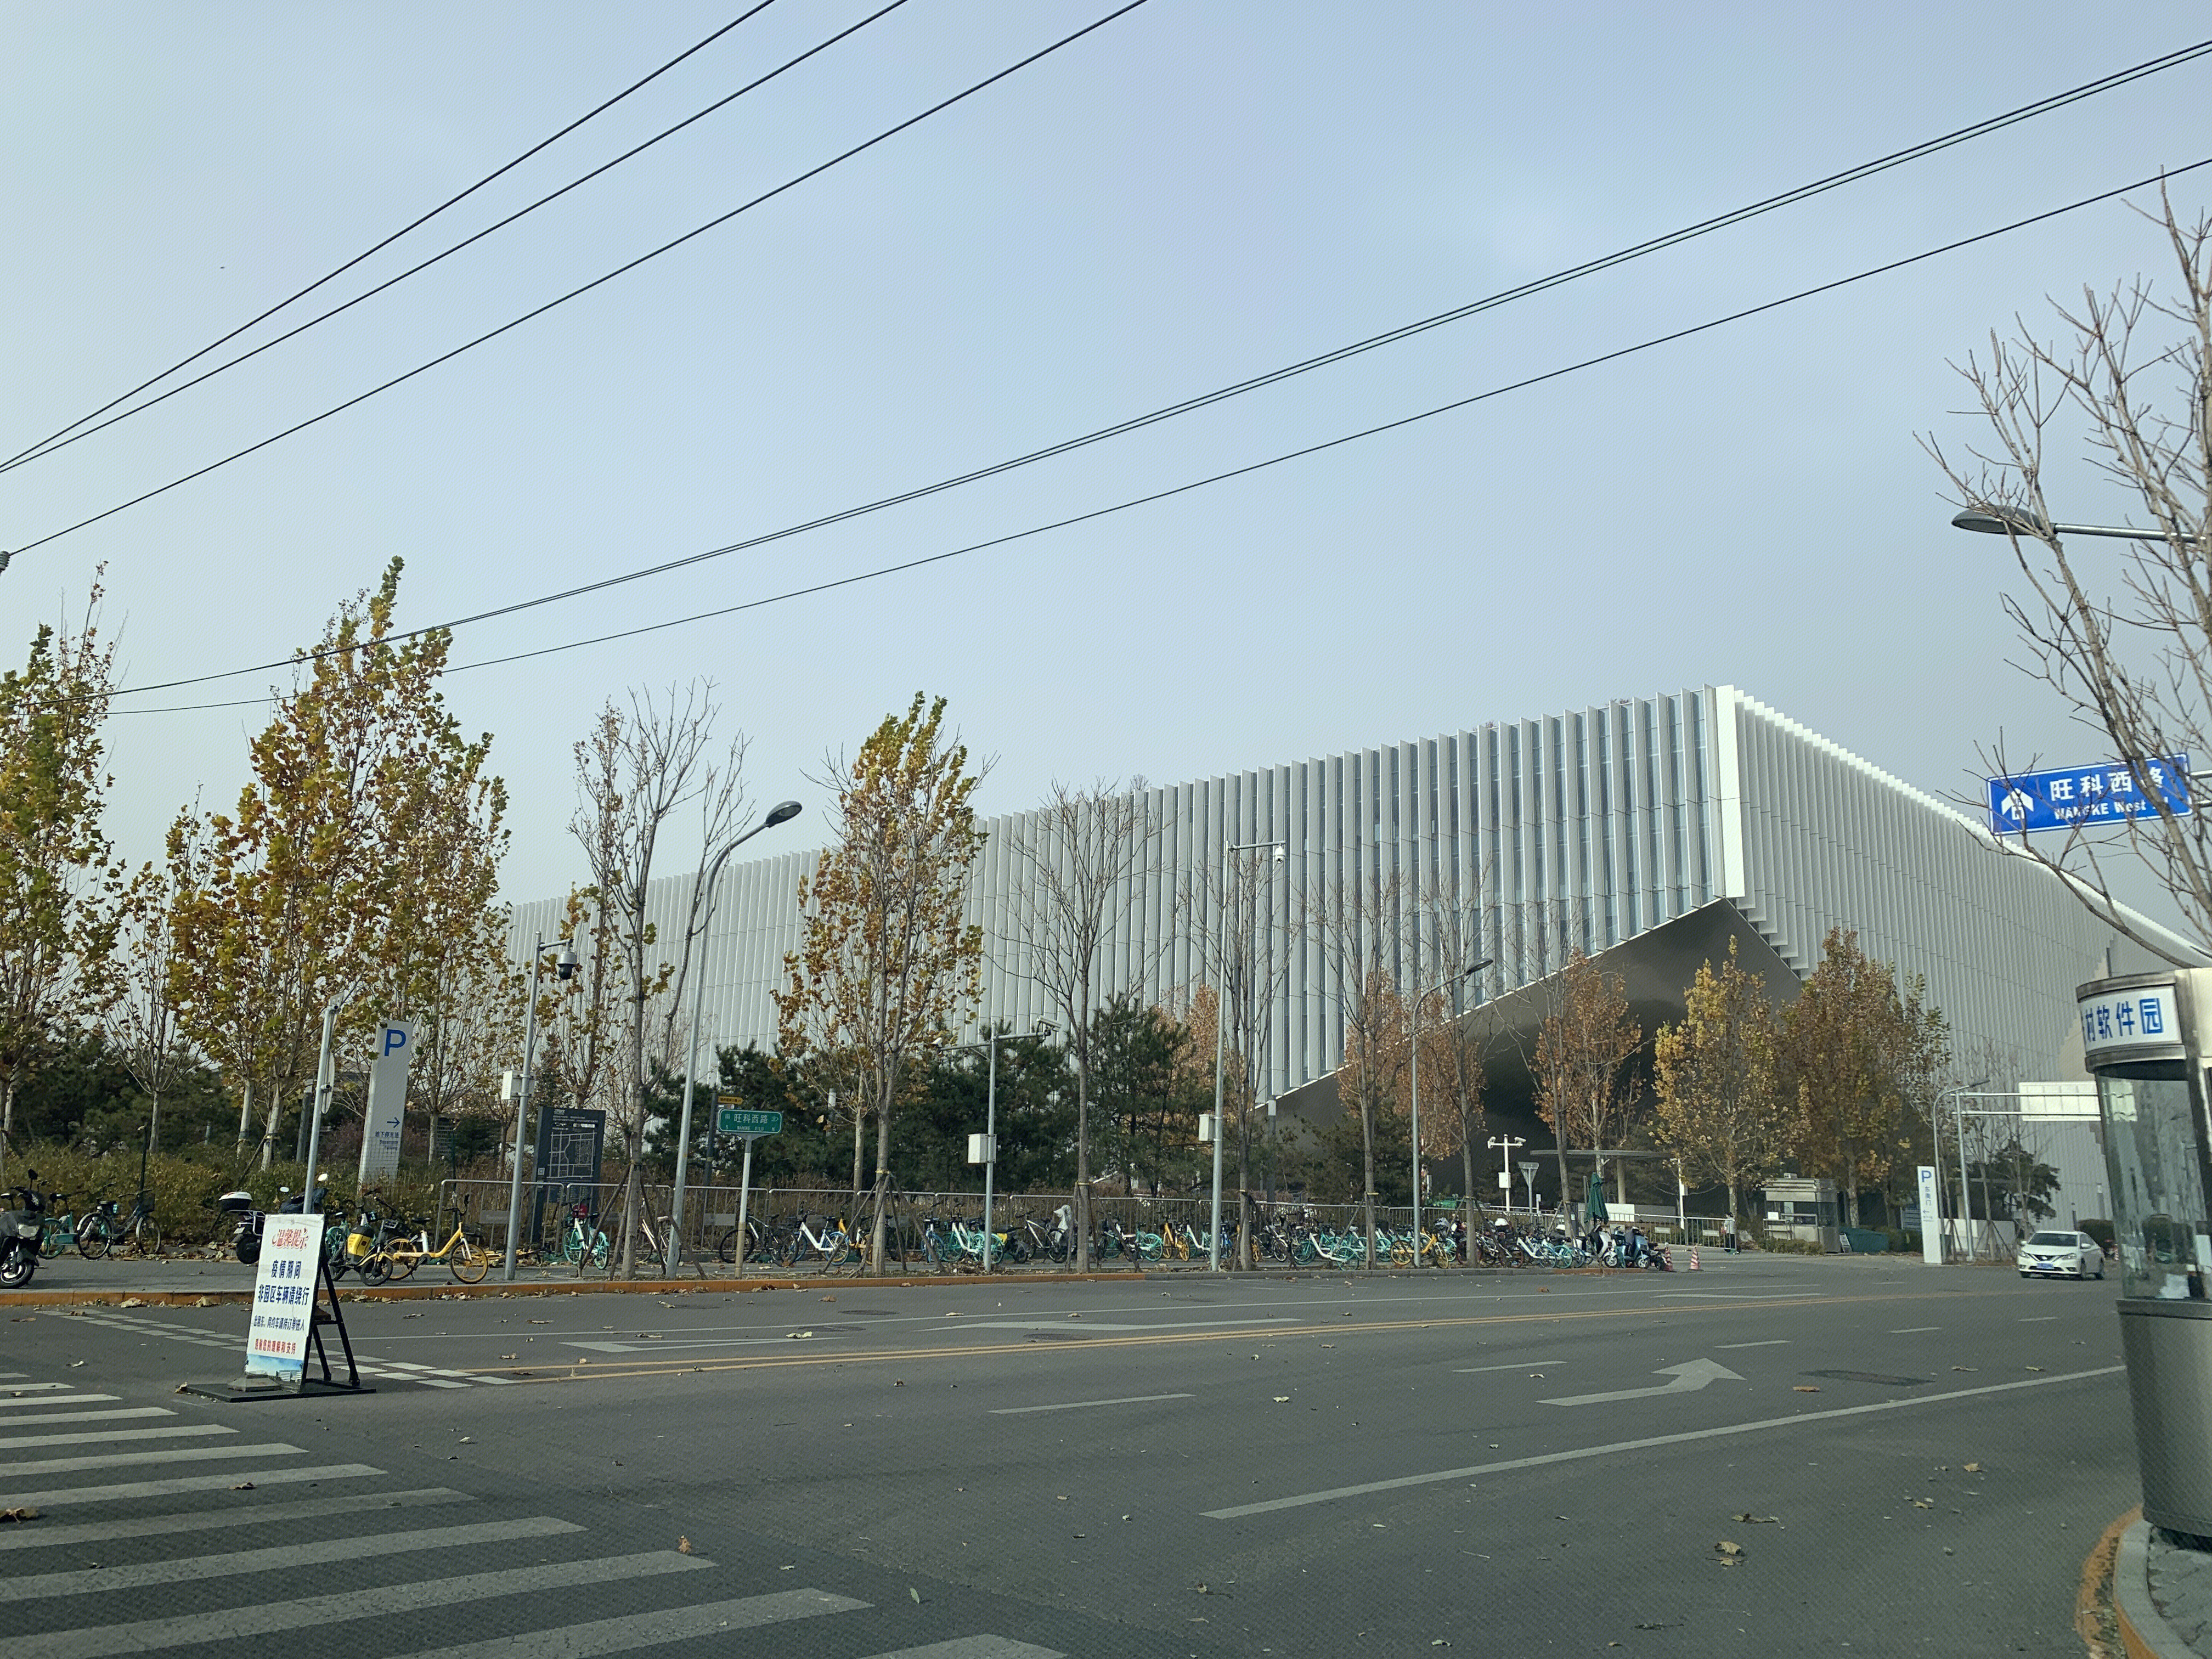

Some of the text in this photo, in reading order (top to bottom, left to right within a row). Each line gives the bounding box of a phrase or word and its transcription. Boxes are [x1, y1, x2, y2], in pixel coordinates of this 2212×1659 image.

[2054, 803, 2109, 820] WANGKE
[2114, 799, 2146, 814] West
[2081, 998, 2164, 1042] 村软件园
[385, 1029, 406, 1057] P
[733, 1113, 768, 1124] 旺科西路
[1921, 1170, 1931, 1182] P
[272, 1227, 309, 1251] 温馨提示
[271, 1260, 302, 1279] 疫情期间
[258, 1284, 310, 1306] 非园区车辆请绕行
